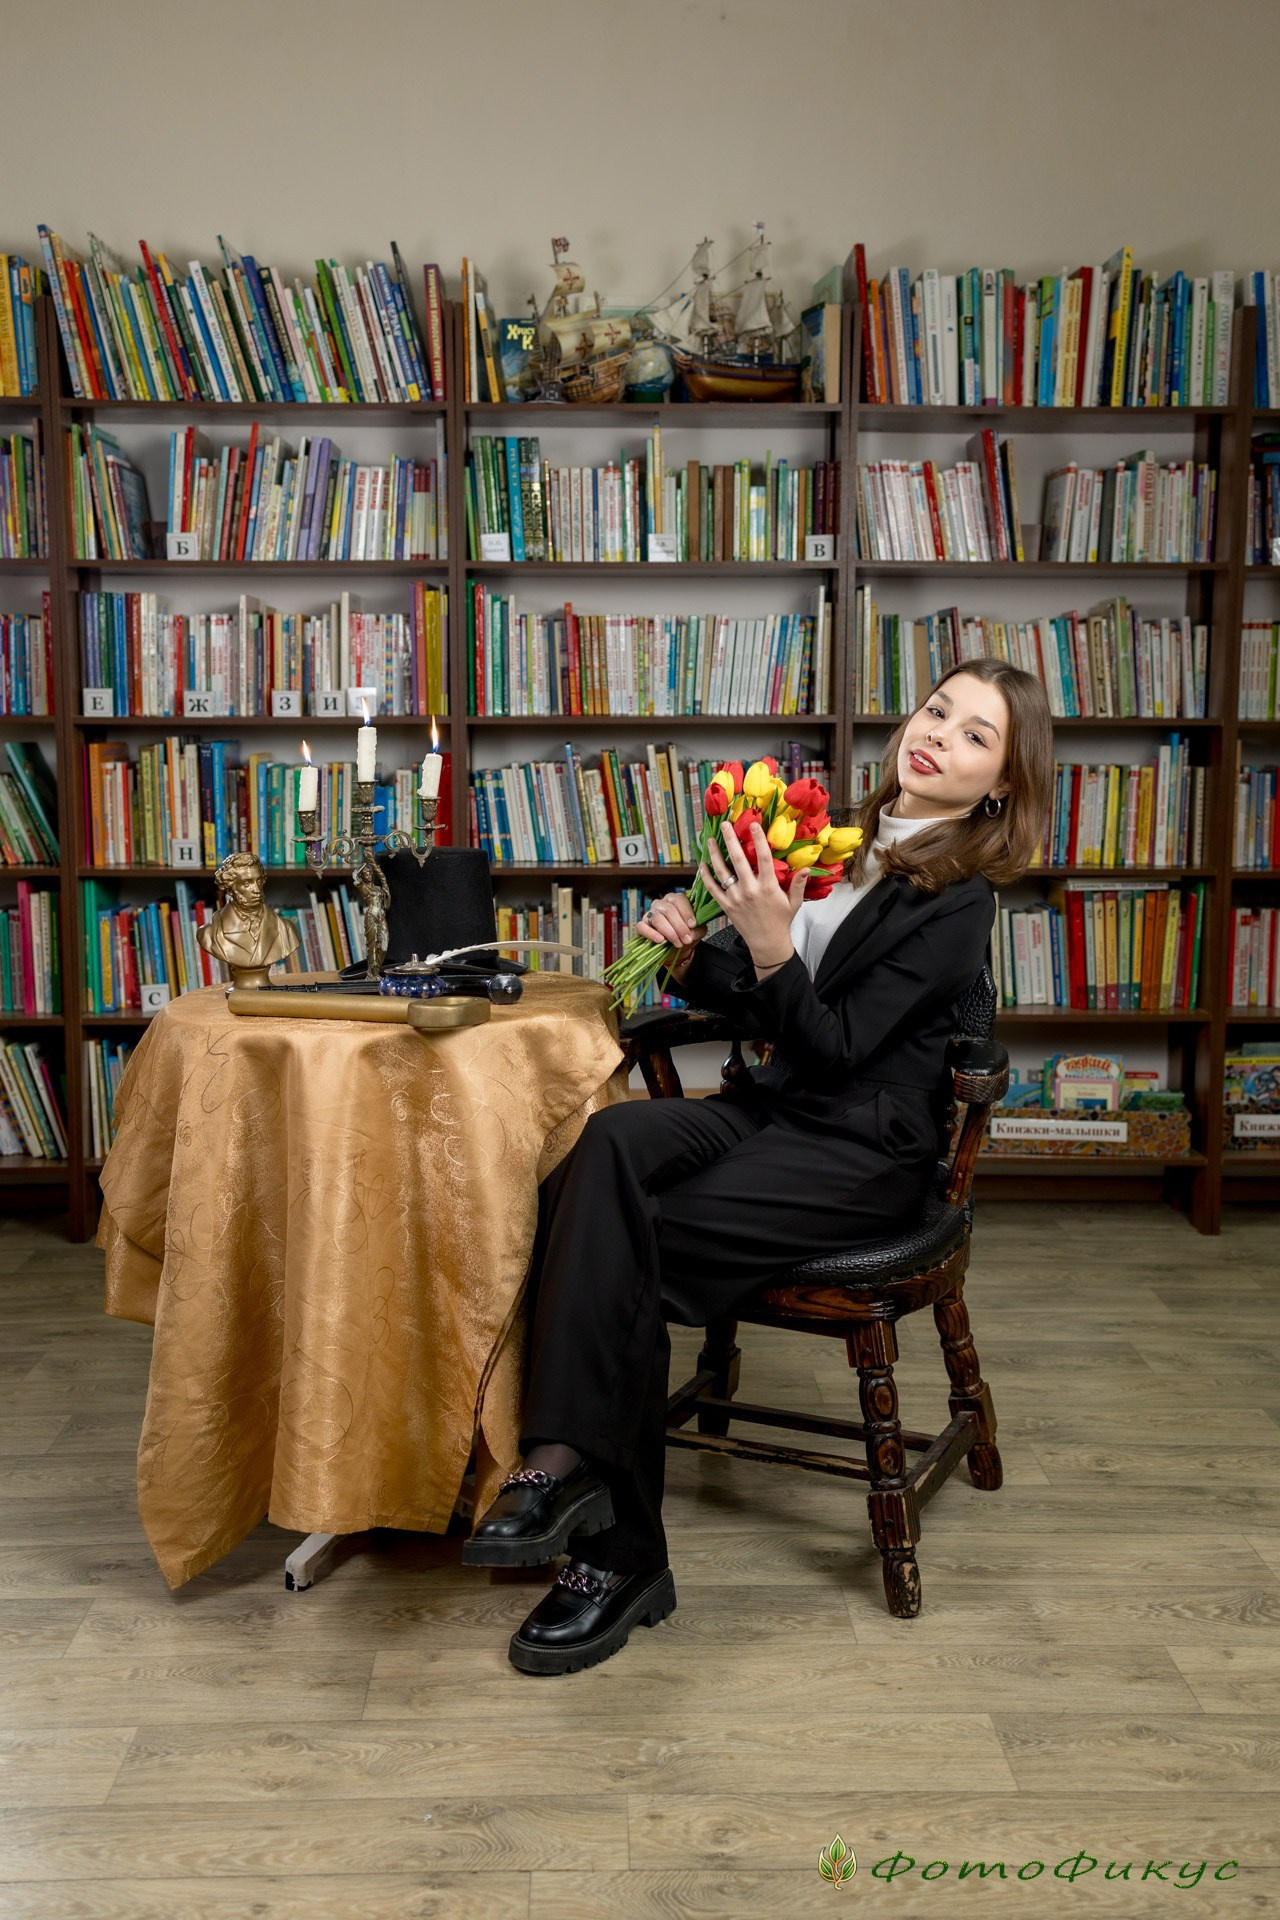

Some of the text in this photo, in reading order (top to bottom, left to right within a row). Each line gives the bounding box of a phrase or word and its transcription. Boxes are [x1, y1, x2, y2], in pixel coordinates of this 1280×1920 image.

[428, 268, 442, 382] НОВАЯ ЭНЦИКЛОПЕДИЯ ШКОЛЬНИКА
[176, 541, 189, 555] Б
[813, 544, 825, 558] В
[92, 697, 103, 711] Е
[188, 698, 209, 713] Ж
[280, 697, 291, 711] З
[323, 697, 338, 711] И
[179, 847, 193, 861] Н
[625, 843, 639, 857] О
[149, 992, 161, 1006] С
[996, 1121, 1121, 1138] Книжки-малышки
[1240, 1120, 1280, 1131] Книж
